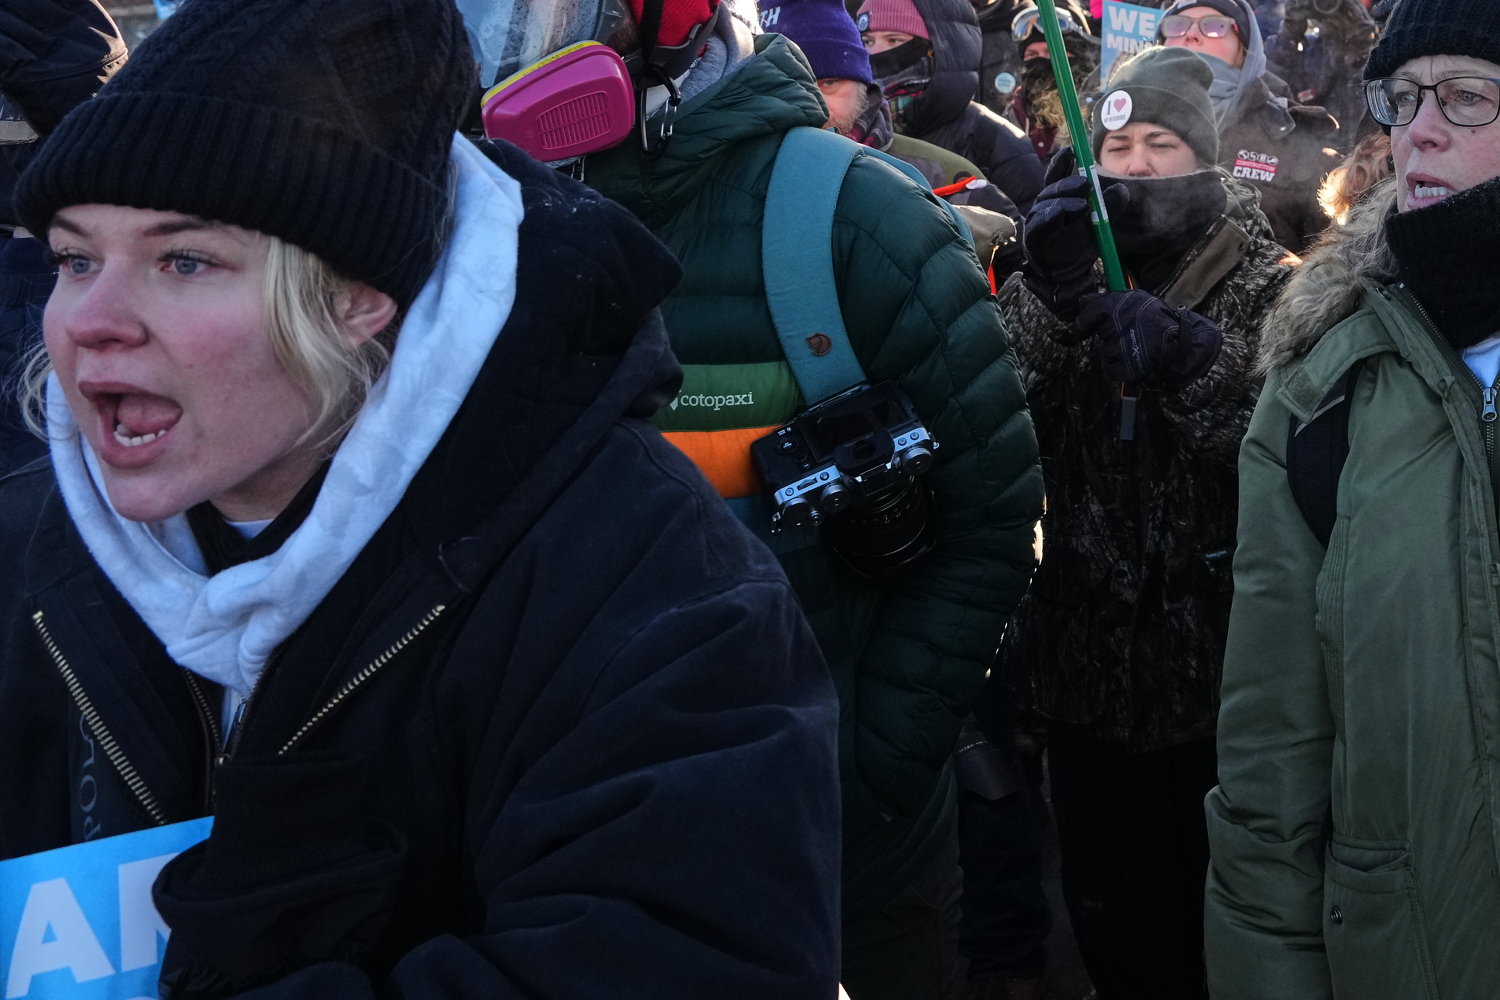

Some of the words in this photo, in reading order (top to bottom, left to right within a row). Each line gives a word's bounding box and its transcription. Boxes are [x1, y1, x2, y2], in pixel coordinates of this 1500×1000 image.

[1108, 5, 1155, 38] WE
[1233, 166, 1276, 182] CREW
[680, 392, 754, 410] cotopaxi
